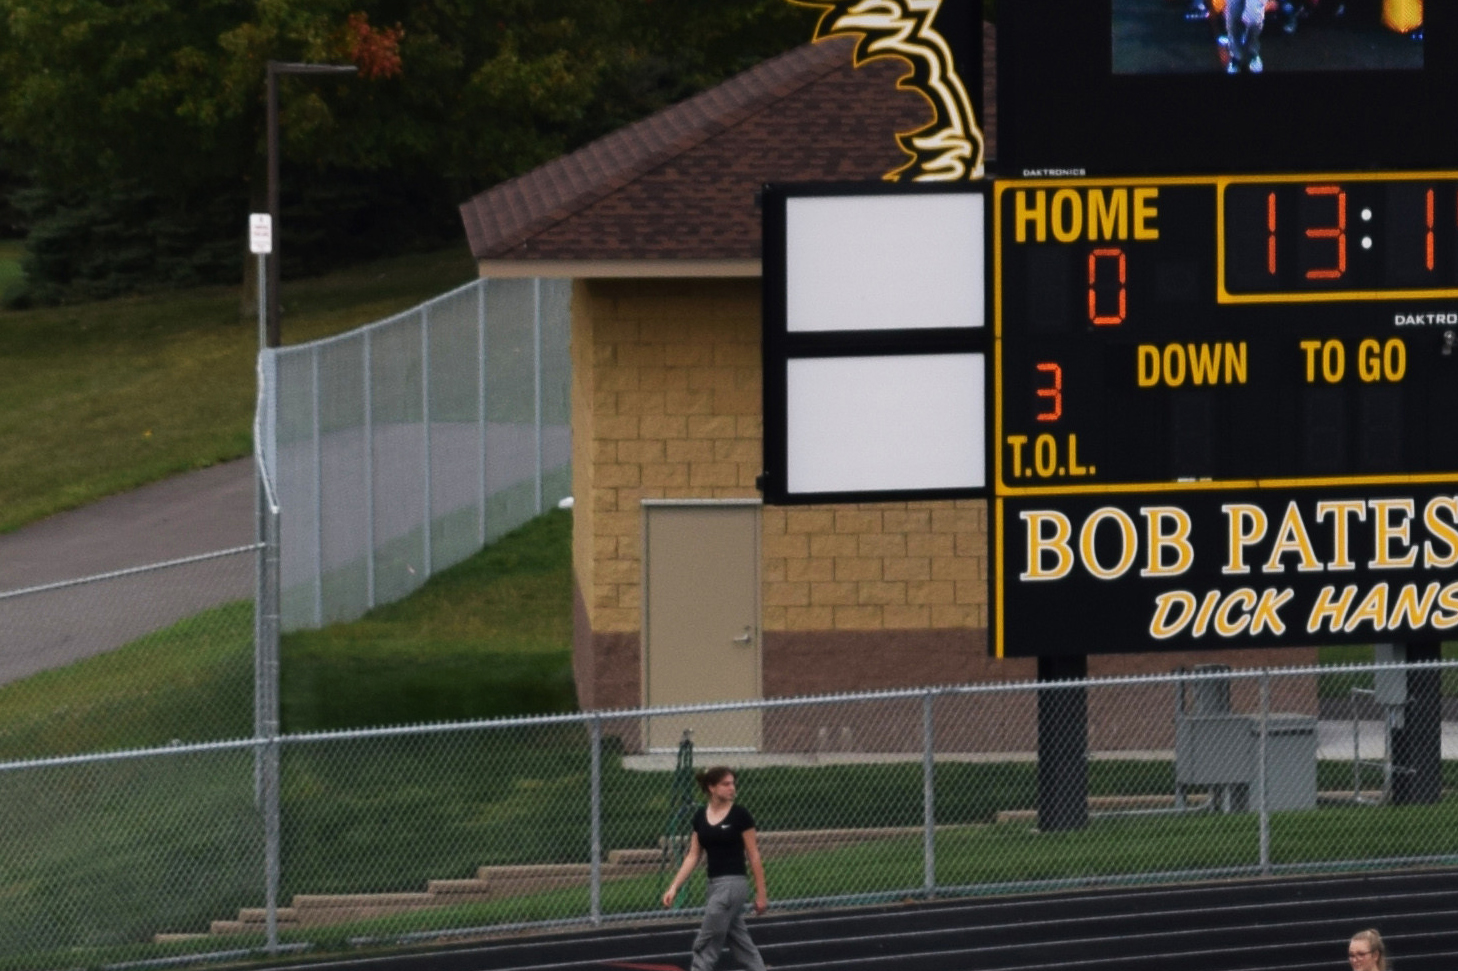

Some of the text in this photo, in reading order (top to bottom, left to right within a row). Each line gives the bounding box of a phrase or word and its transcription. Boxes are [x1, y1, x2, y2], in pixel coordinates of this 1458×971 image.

[1014, 187, 1160, 243] HOME
[1088, 248, 1127, 325] 0
[1137, 342, 1248, 388] DOWN
[1300, 338, 1407, 383] TO GO
[1036, 362, 1063, 421] 3
[1006, 434, 1096, 477] T.O.L.
[1019, 507, 1195, 582] BOB
[1148, 587, 1294, 640] DICK
